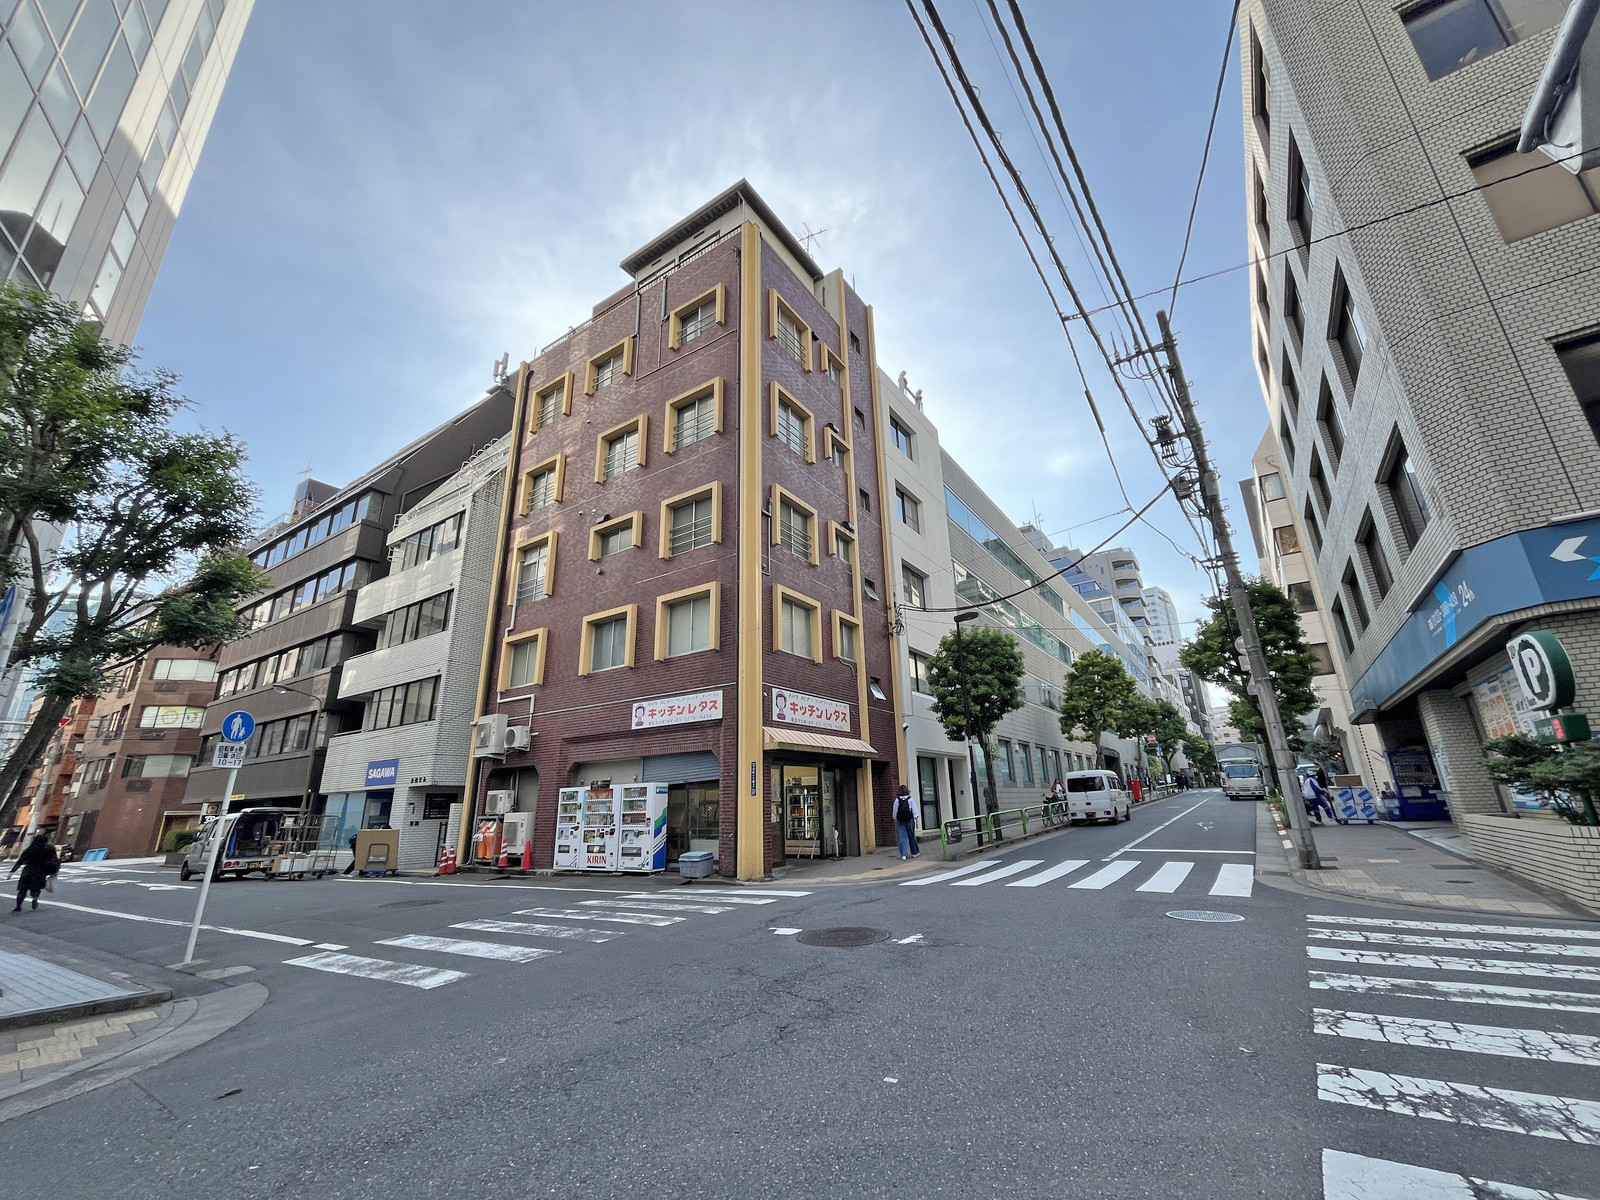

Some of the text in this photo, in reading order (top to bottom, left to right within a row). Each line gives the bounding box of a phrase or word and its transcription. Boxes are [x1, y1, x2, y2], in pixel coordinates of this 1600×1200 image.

[1520, 648, 1541, 693] P
[648, 700, 718, 718] キッチンレタス
[789, 702, 848, 723] キッチンレタス
[368, 767, 395, 779] SAGAWA
[586, 855, 607, 865] KIRIN
